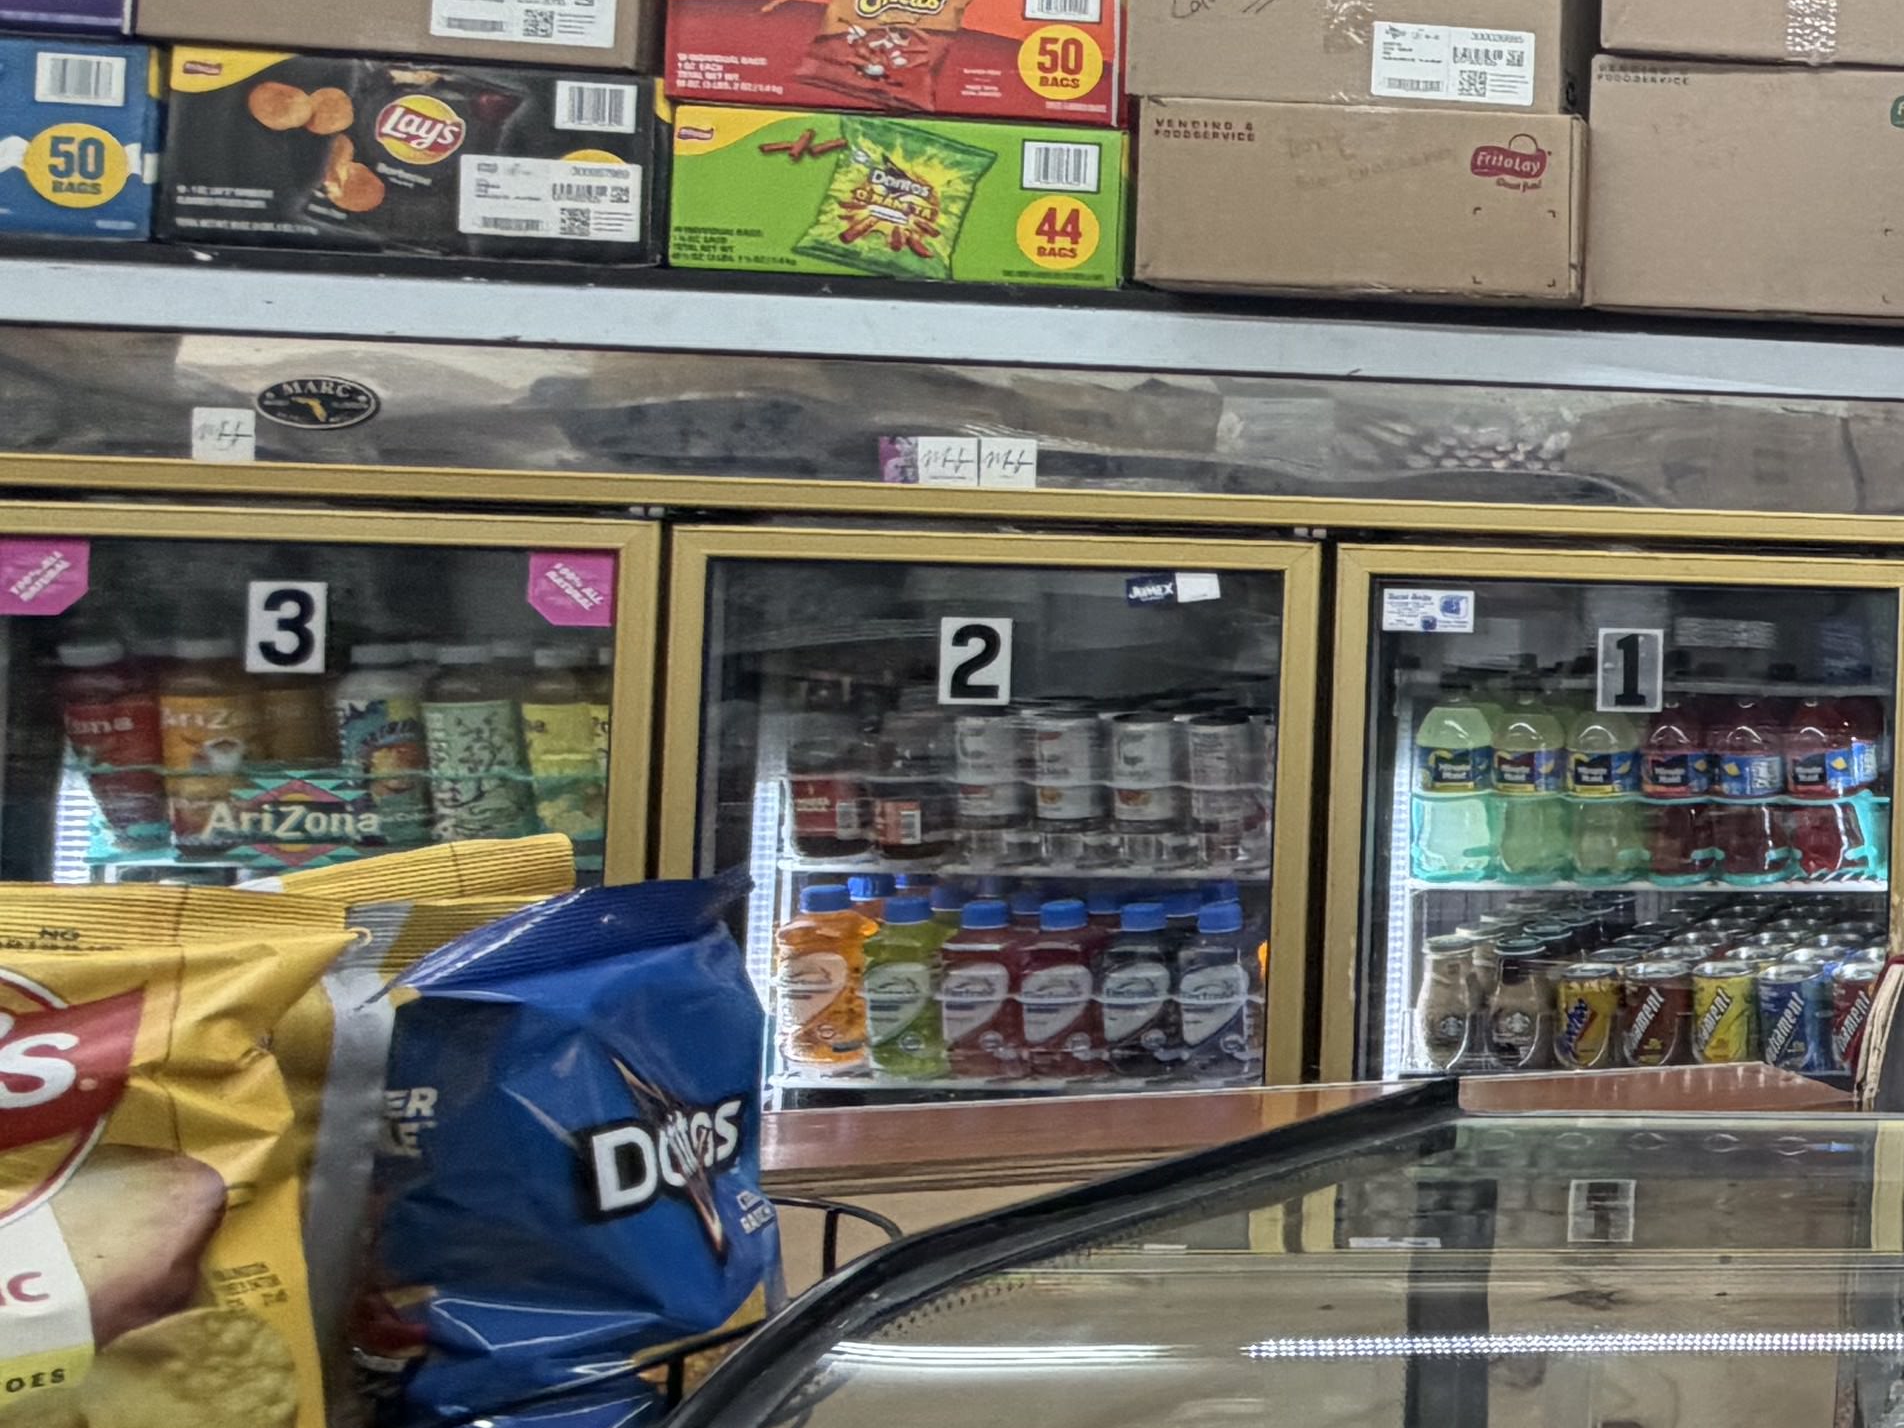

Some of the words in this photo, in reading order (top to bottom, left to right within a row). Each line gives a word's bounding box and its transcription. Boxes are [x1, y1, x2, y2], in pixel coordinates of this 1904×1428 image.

[1037, 37, 1084, 76] 50
[1039, 77, 1080, 89] BAGS
[48, 136, 105, 181] 50
[52, 181, 103, 195] BAGS
[871, 169, 932, 199] Doritos
[1035, 207, 1082, 246] 44
[1037, 246, 1078, 259] BAGS
[281, 380, 352, 398] MARC
[257, 588, 316, 666] 3
[949, 623, 1002, 699] 2
[1613, 632, 1648, 706] 1
[199, 801, 382, 841] AriZona
